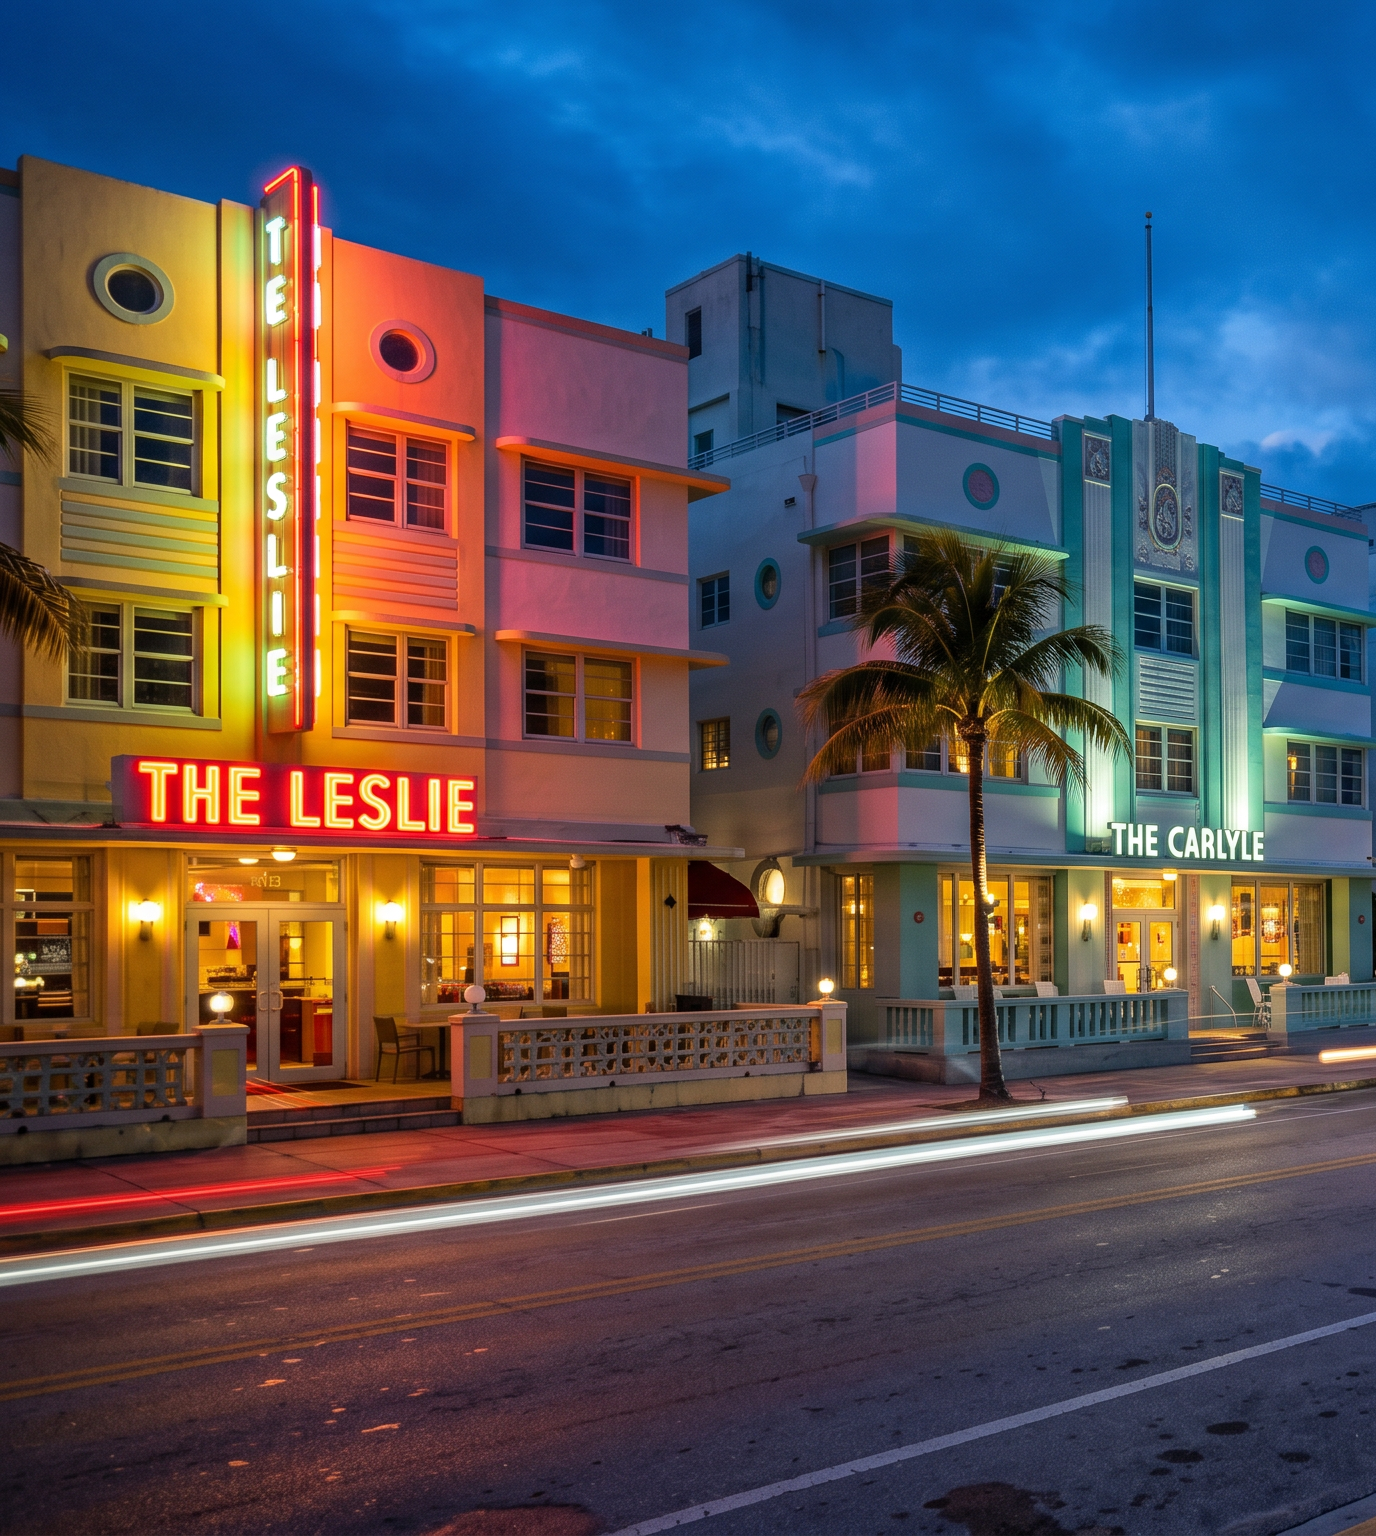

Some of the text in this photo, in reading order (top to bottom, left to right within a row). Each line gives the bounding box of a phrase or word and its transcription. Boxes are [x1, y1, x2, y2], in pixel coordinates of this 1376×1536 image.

[266, 357, 288, 698] LESLIE
[138, 761, 475, 834] THE LESLIE
[1109, 822, 1265, 862] THE CARLYLE
